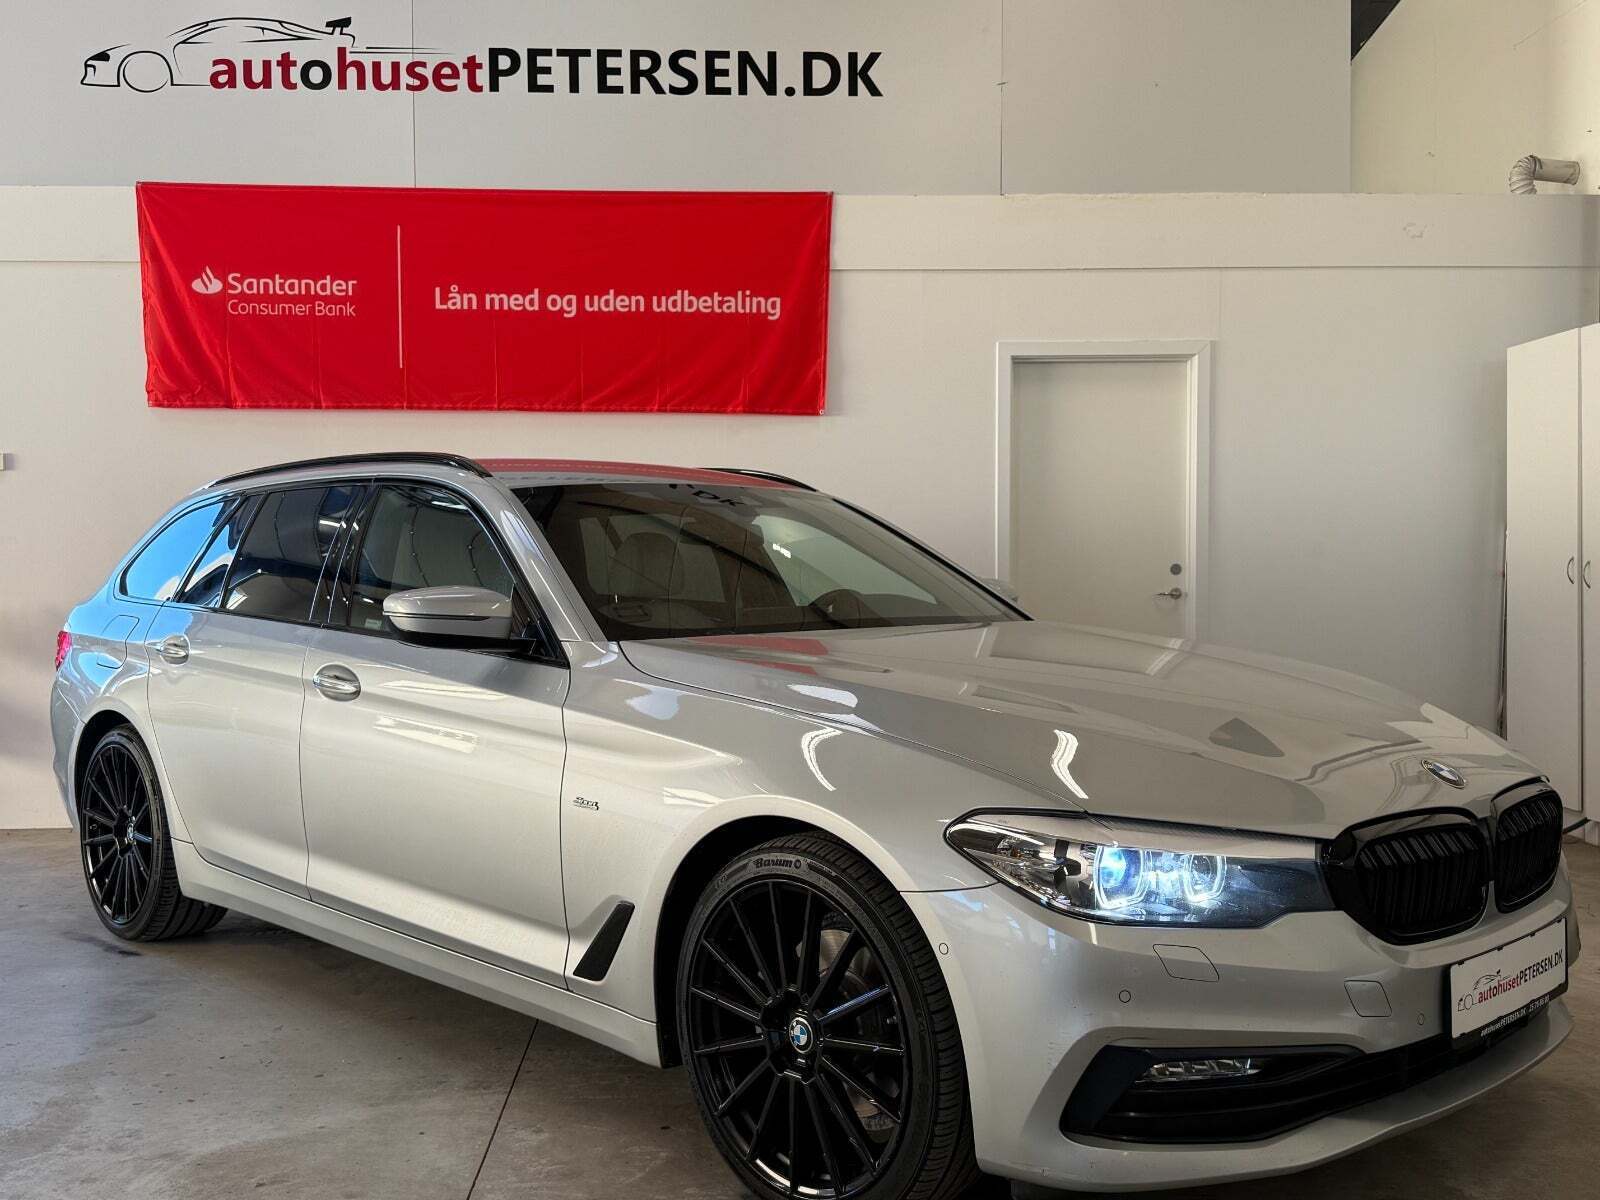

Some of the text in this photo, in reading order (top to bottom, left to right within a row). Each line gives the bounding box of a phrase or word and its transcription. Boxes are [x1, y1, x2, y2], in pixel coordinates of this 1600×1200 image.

[208, 47, 883, 97] autohusetPETERSEN.DK
[227, 272, 358, 296] Santander
[227, 299, 356, 317] Consumer Bank
[434, 284, 781, 321] Lån med og uden udbetaling
[754, 857, 792, 869] Barum
[1478, 949, 1563, 1004] autohusetPETERSEN.DK
